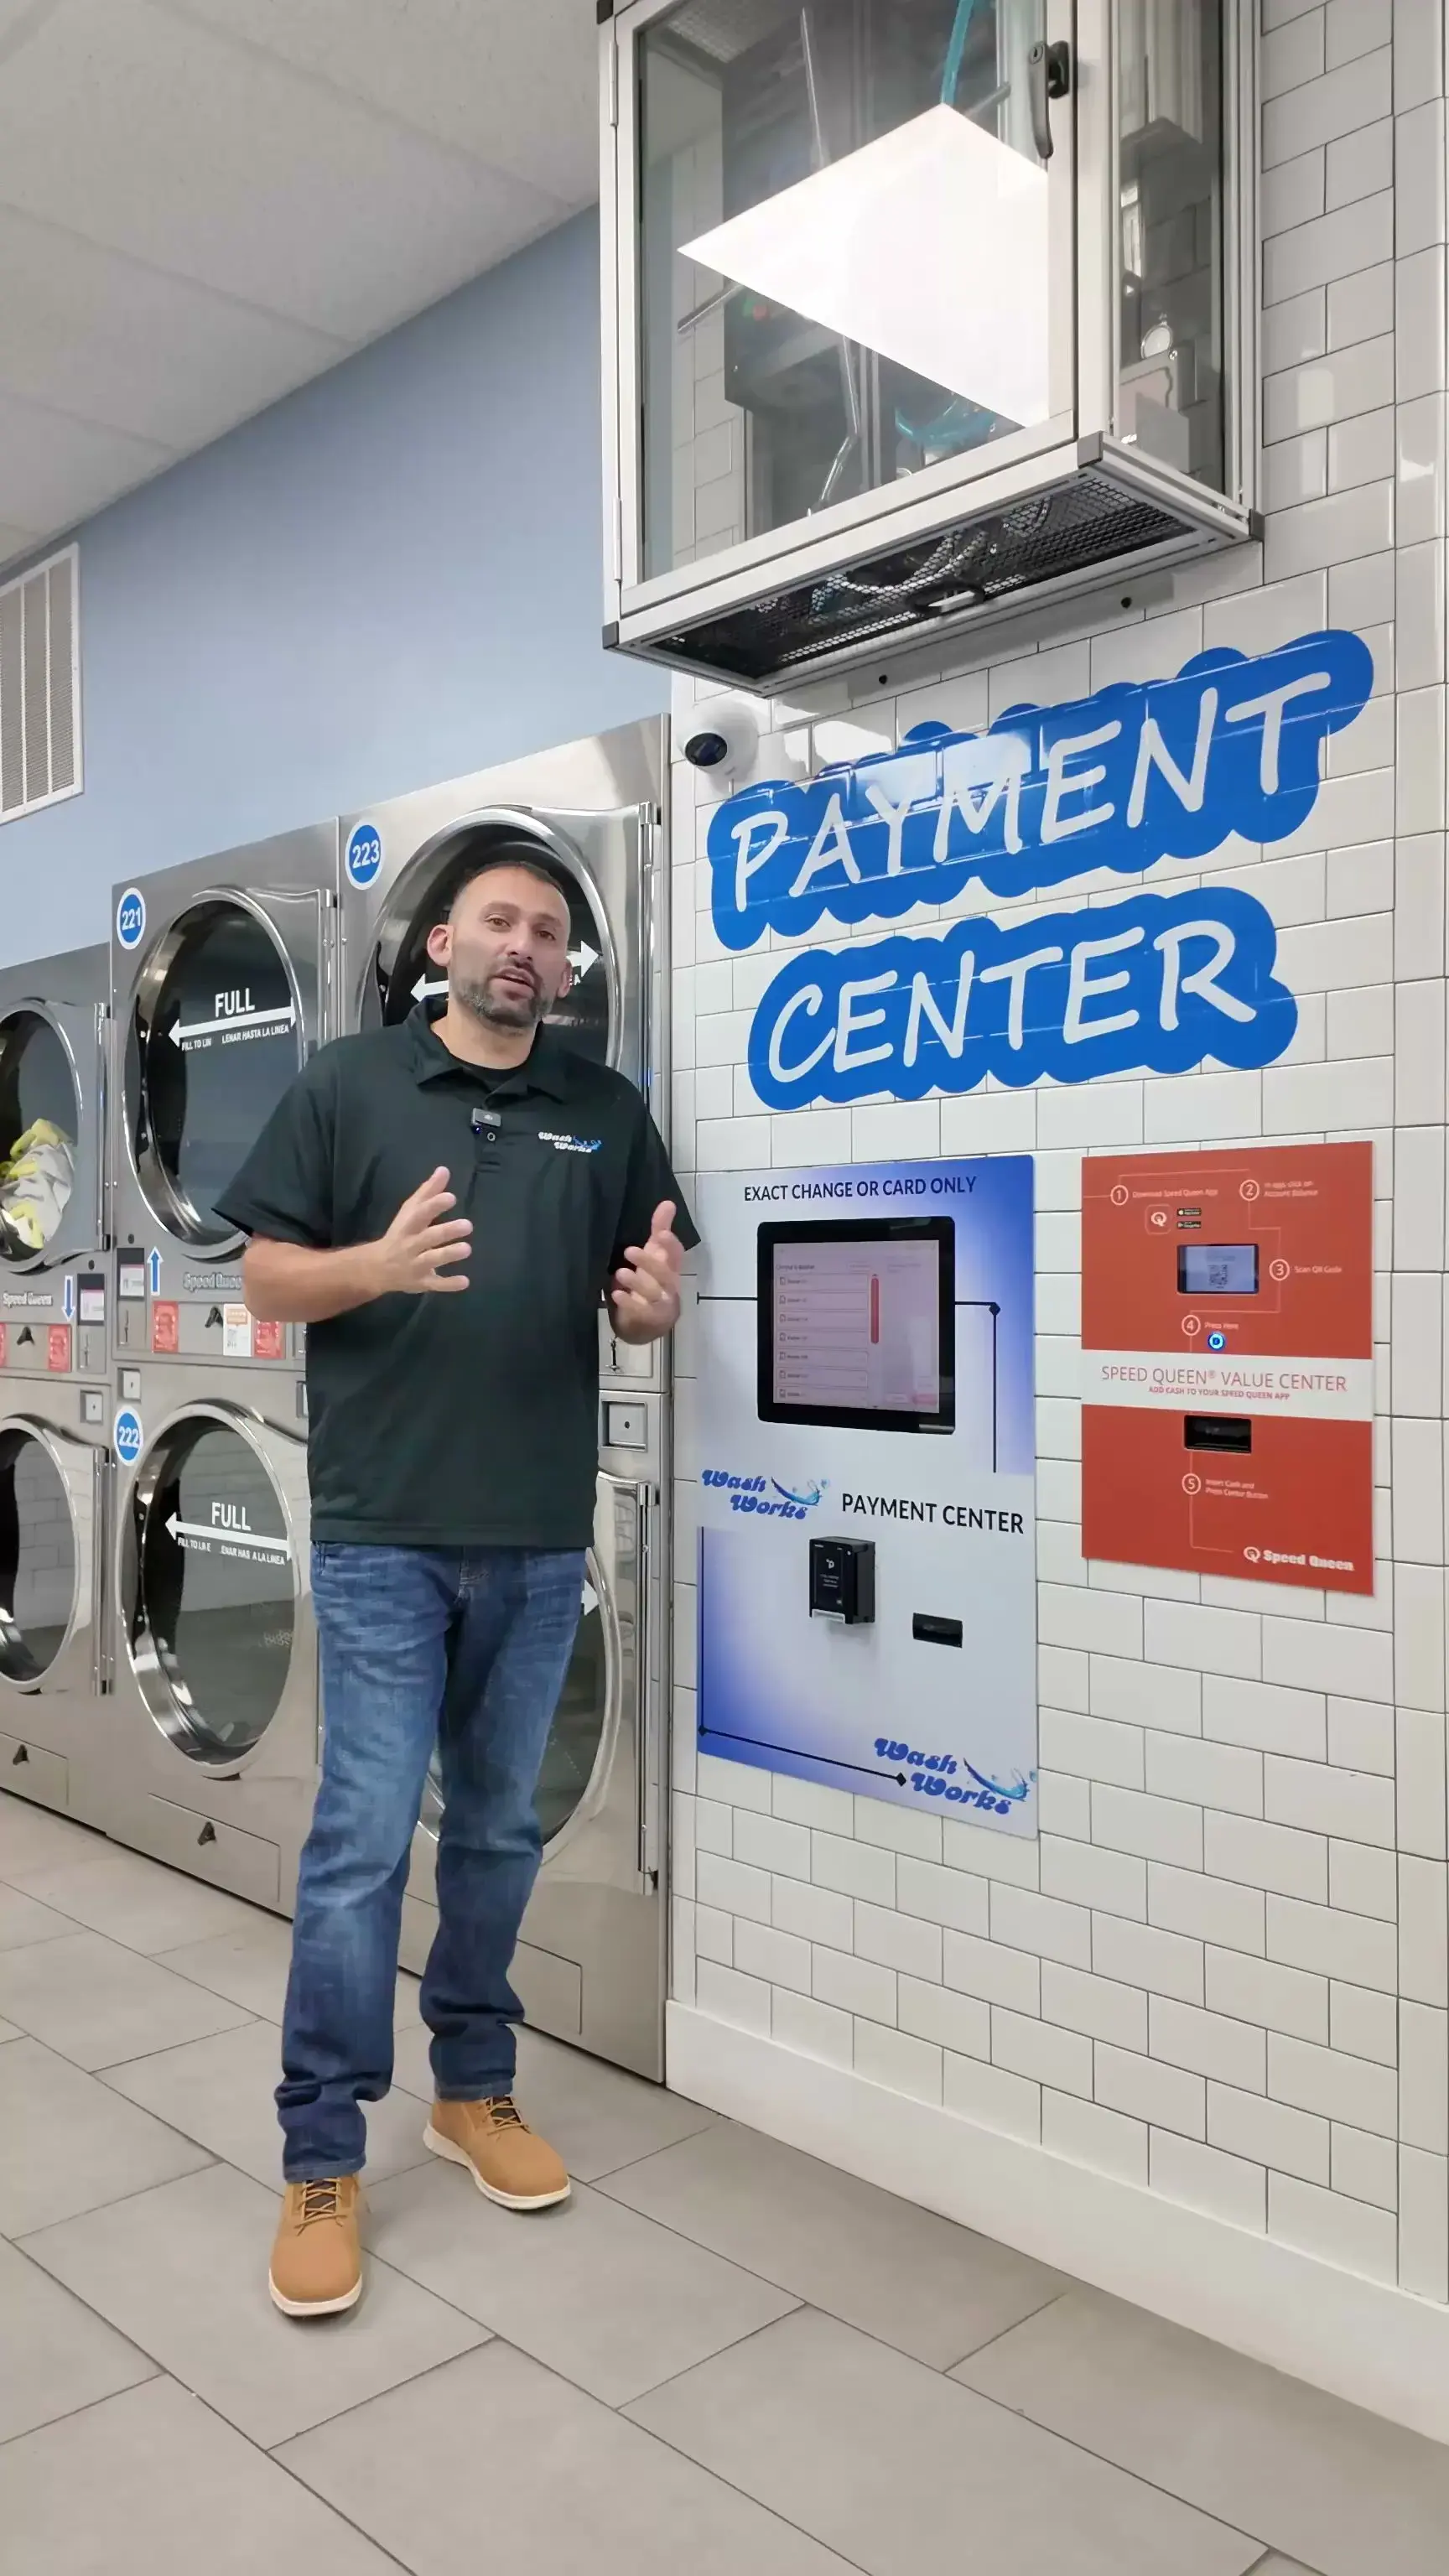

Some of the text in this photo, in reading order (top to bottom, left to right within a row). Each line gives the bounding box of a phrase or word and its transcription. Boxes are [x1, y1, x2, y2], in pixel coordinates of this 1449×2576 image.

[730, 672, 1331, 912] PAYMENT
[352, 839, 380, 869] 223
[122, 906, 141, 931] 221
[215, 988, 255, 1018] FULL
[768, 920, 1257, 1083] CENTER
[242, 1030, 262, 1041] HASTA
[262, 1027, 271, 1038] LA
[270, 1024, 289, 1036] LINEA
[181, 1040, 193, 1052] FILL
[194, 1039, 202, 1050] TO
[744, 1176, 977, 1202] EXACT CHANGE OR CARD ONLY
[1115, 1189, 1123, 1202] 1
[1183, 1188, 1203, 1197] Queen
[1245, 1184, 1254, 1197] 2
[183, 1271, 242, 1292] Speed Quee
[1276, 1264, 1285, 1276] 3
[1187, 1320, 1194, 1332] 4
[1101, 1366, 1148, 1382] SPEED
[1221, 1371, 1275, 1389] VALUE
[1279, 1374, 1348, 1392] CENTER
[1166, 1387, 1184, 1395] CASH
[1198, 1389, 1219, 1397] YOUR
[1221, 1389, 1244, 1398] SPEED
[1246, 1391, 1273, 1400] QUEEN
[1275, 1393, 1291, 1401] APP
[118, 1426, 139, 1447] 222
[701, 1468, 767, 1493] Wash
[1188, 1478, 1196, 1490] 5
[211, 1502, 252, 1531] FULL
[730, 1494, 809, 1520] Works
[842, 1493, 1025, 1535] PAYMENT CENTER
[190, 1540, 198, 1550] TO
[1263, 1550, 1306, 1565] Speed
[1309, 1555, 1355, 1571] Queen
[874, 1737, 958, 1775] Wash
[911, 1771, 1012, 1815] Works
